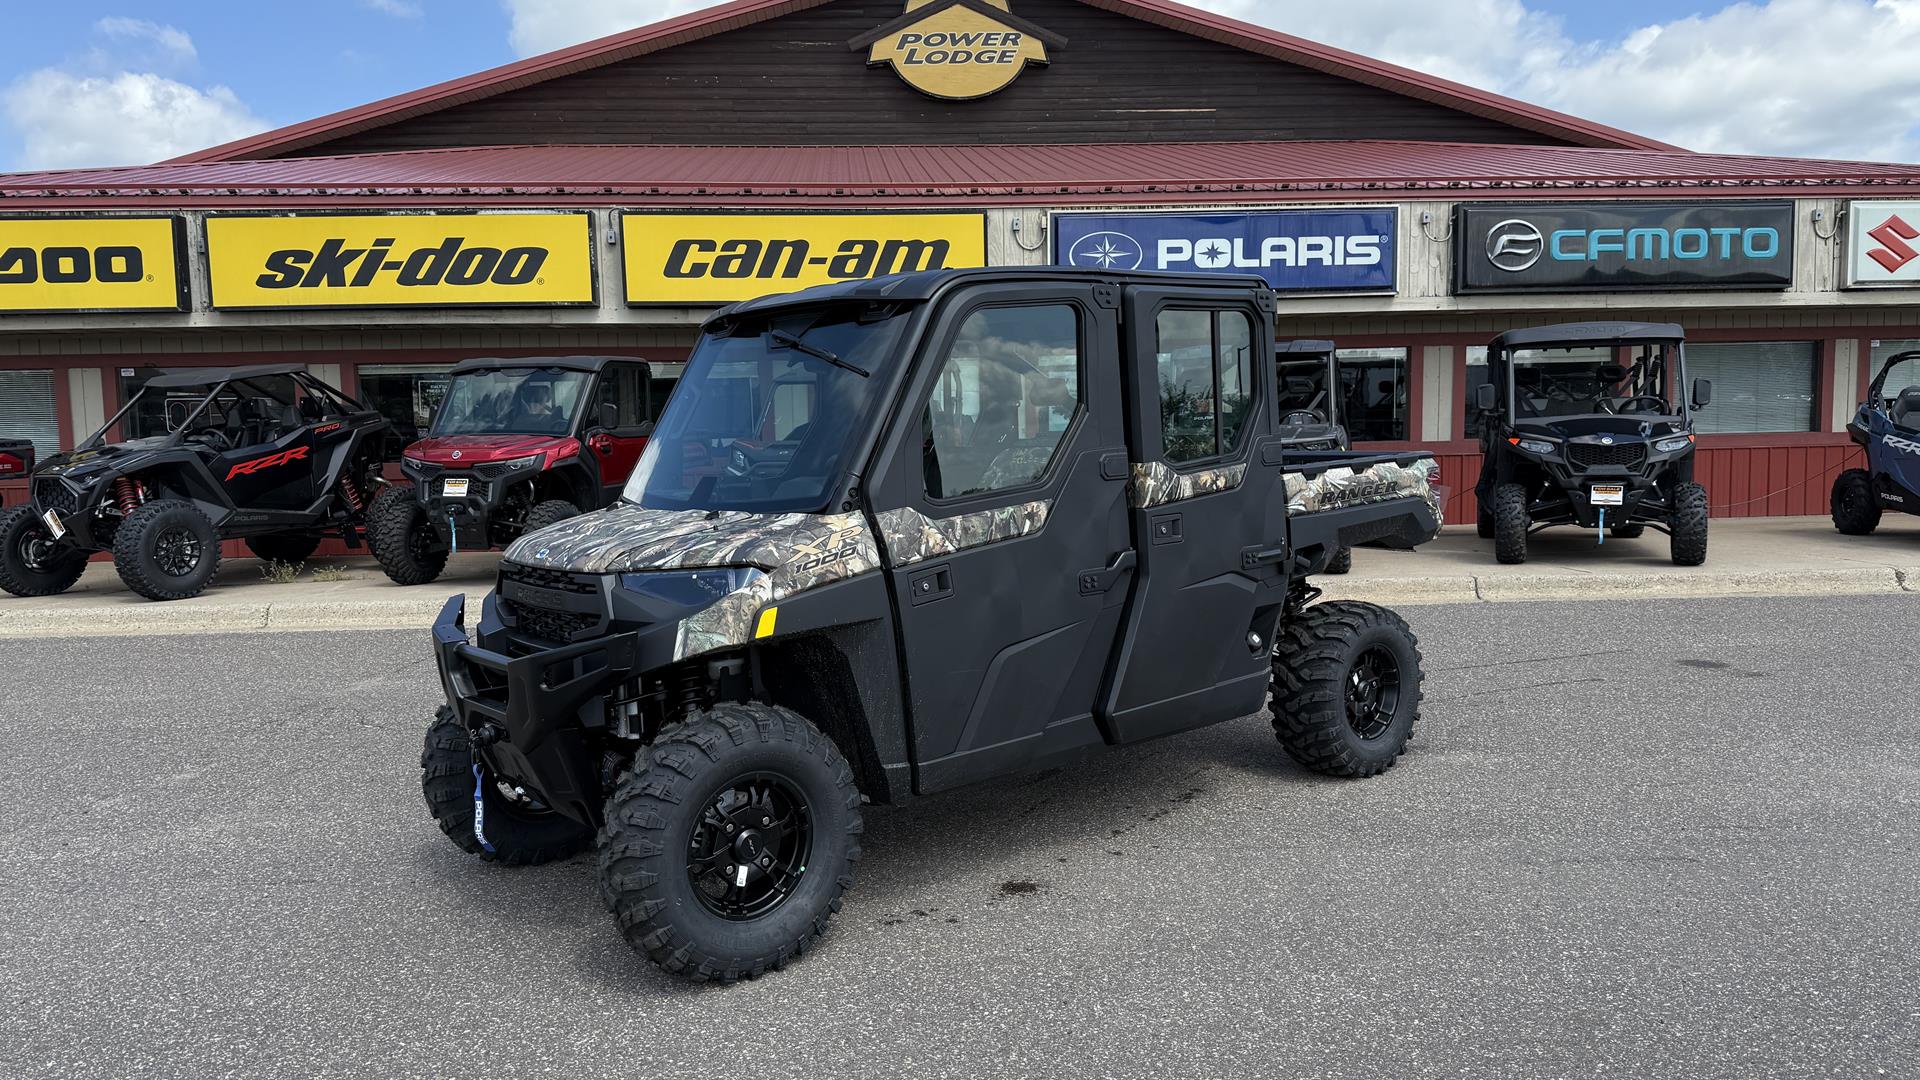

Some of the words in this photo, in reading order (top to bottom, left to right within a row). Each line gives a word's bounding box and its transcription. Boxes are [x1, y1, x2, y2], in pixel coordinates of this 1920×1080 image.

[896, 32, 1022, 50] POWER
[903, 48, 1018, 65] LODGE
[663, 239, 950, 278] can-am
[1157, 235, 1381, 270] POLARIS
[1550, 227, 1779, 261] CFMOTO
[255, 237, 549, 289] ski-doo
[314, 423, 341, 435] PRO
[225, 446, 310, 481] RZR
[1320, 481, 1398, 504] RANGER
[1880, 492, 1903, 503] POLARIS
[785, 525, 864, 564] XP
[795, 544, 858, 574] 1000
